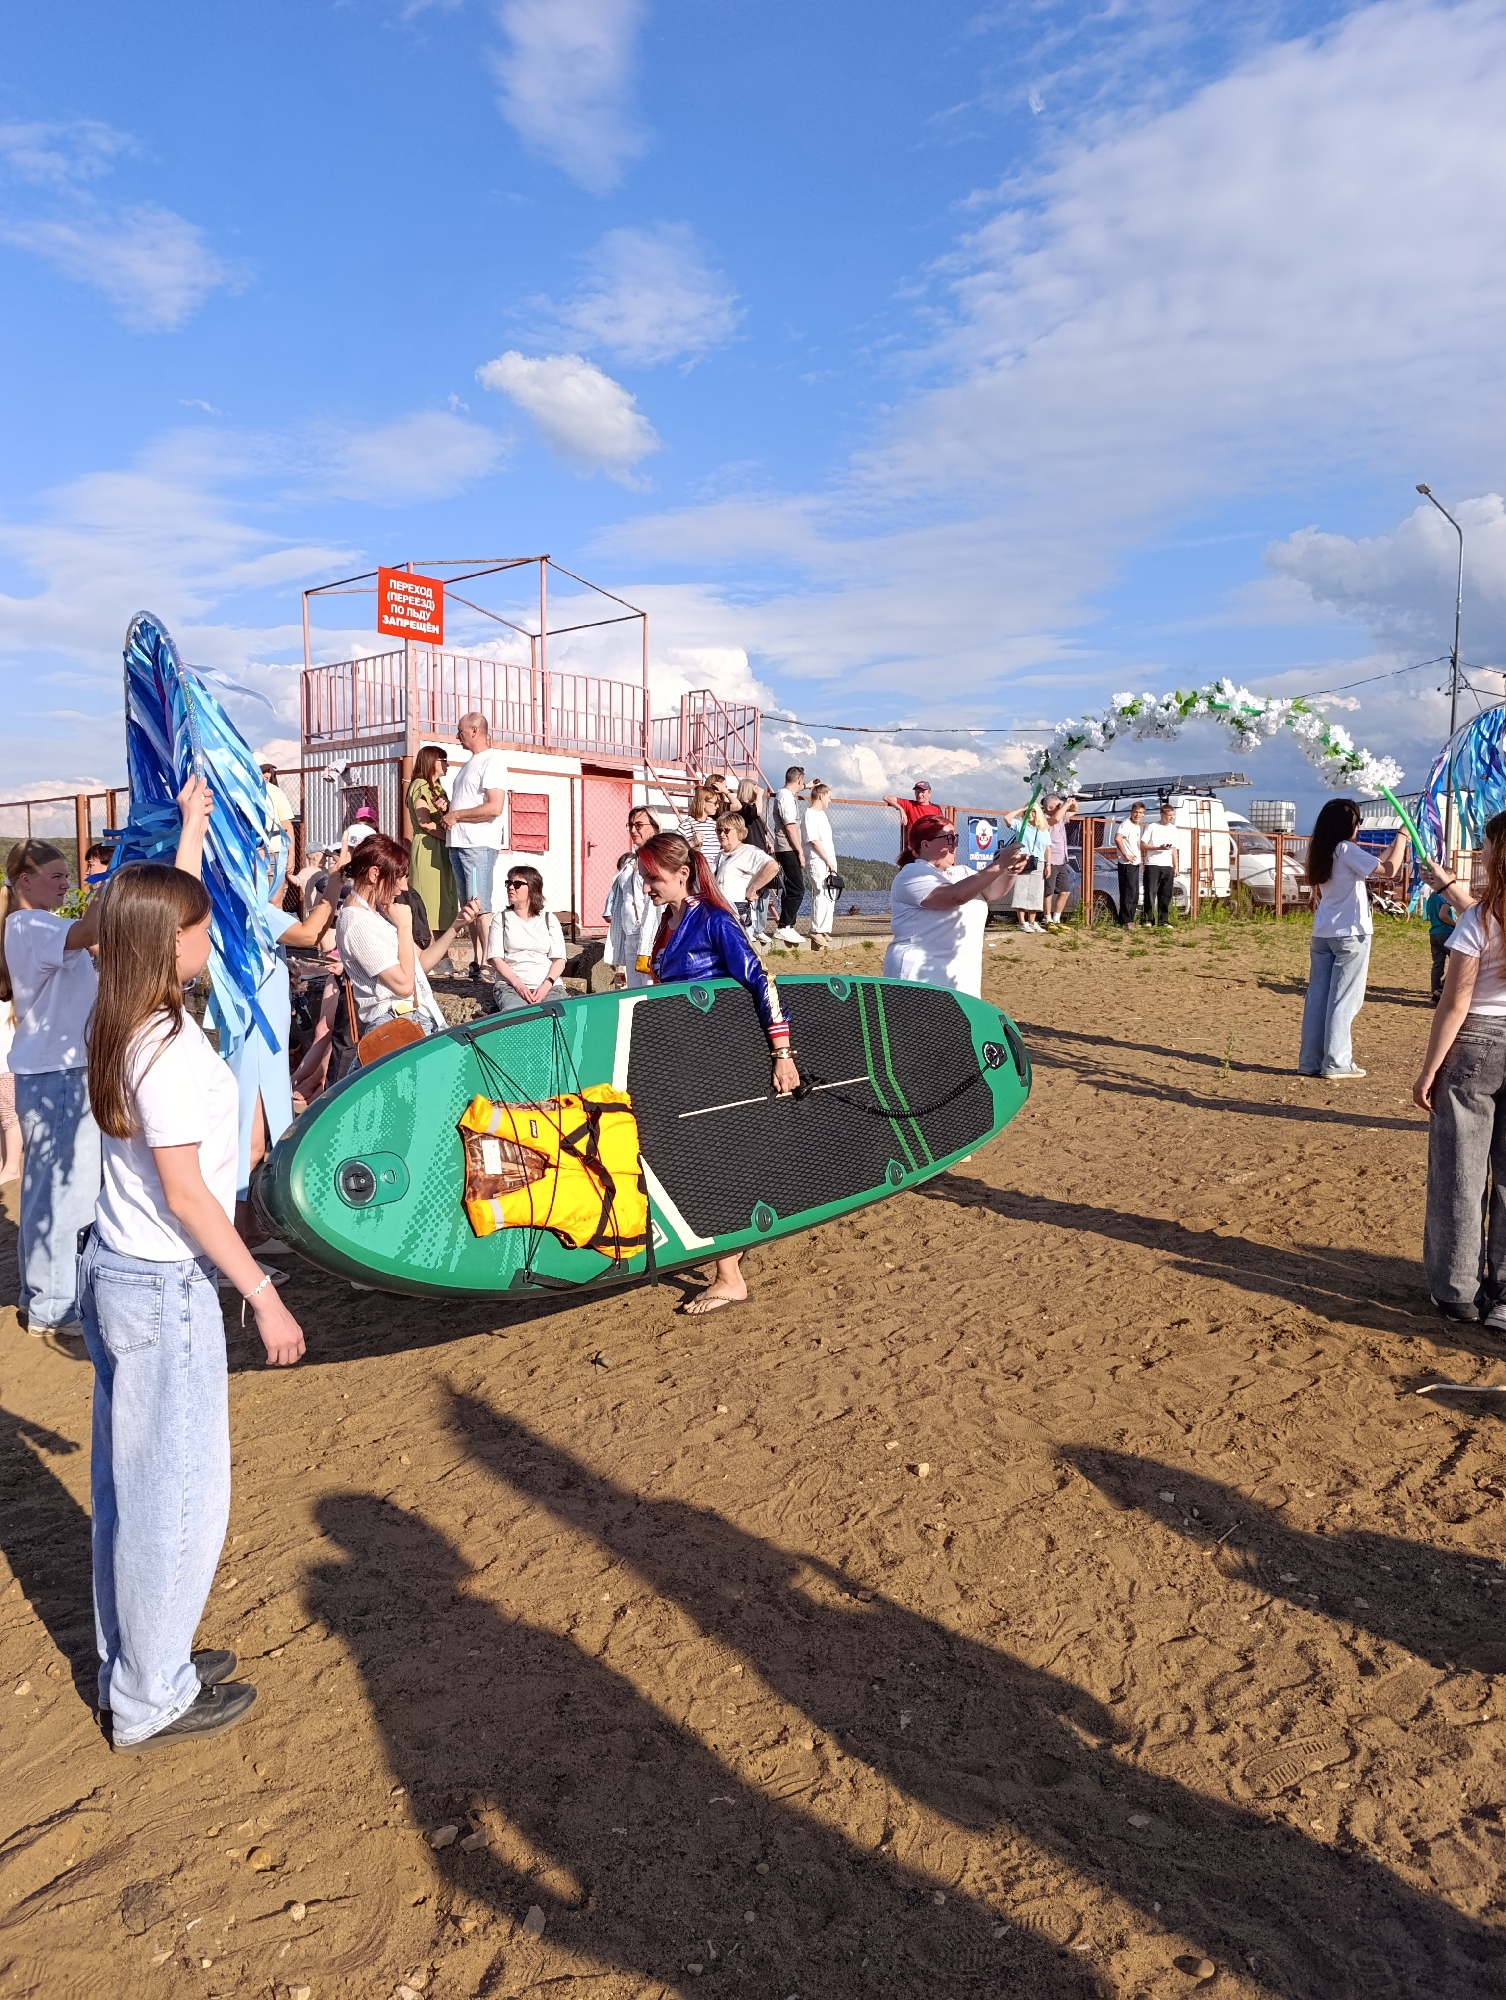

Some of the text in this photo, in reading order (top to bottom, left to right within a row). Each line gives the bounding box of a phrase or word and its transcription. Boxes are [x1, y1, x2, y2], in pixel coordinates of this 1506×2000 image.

[389, 579, 433, 599] ПЕРЕХОД
[387, 591, 435, 611] (ПЕРЕЕЗД)
[391, 604, 431, 621] ПО ЛЬДУ
